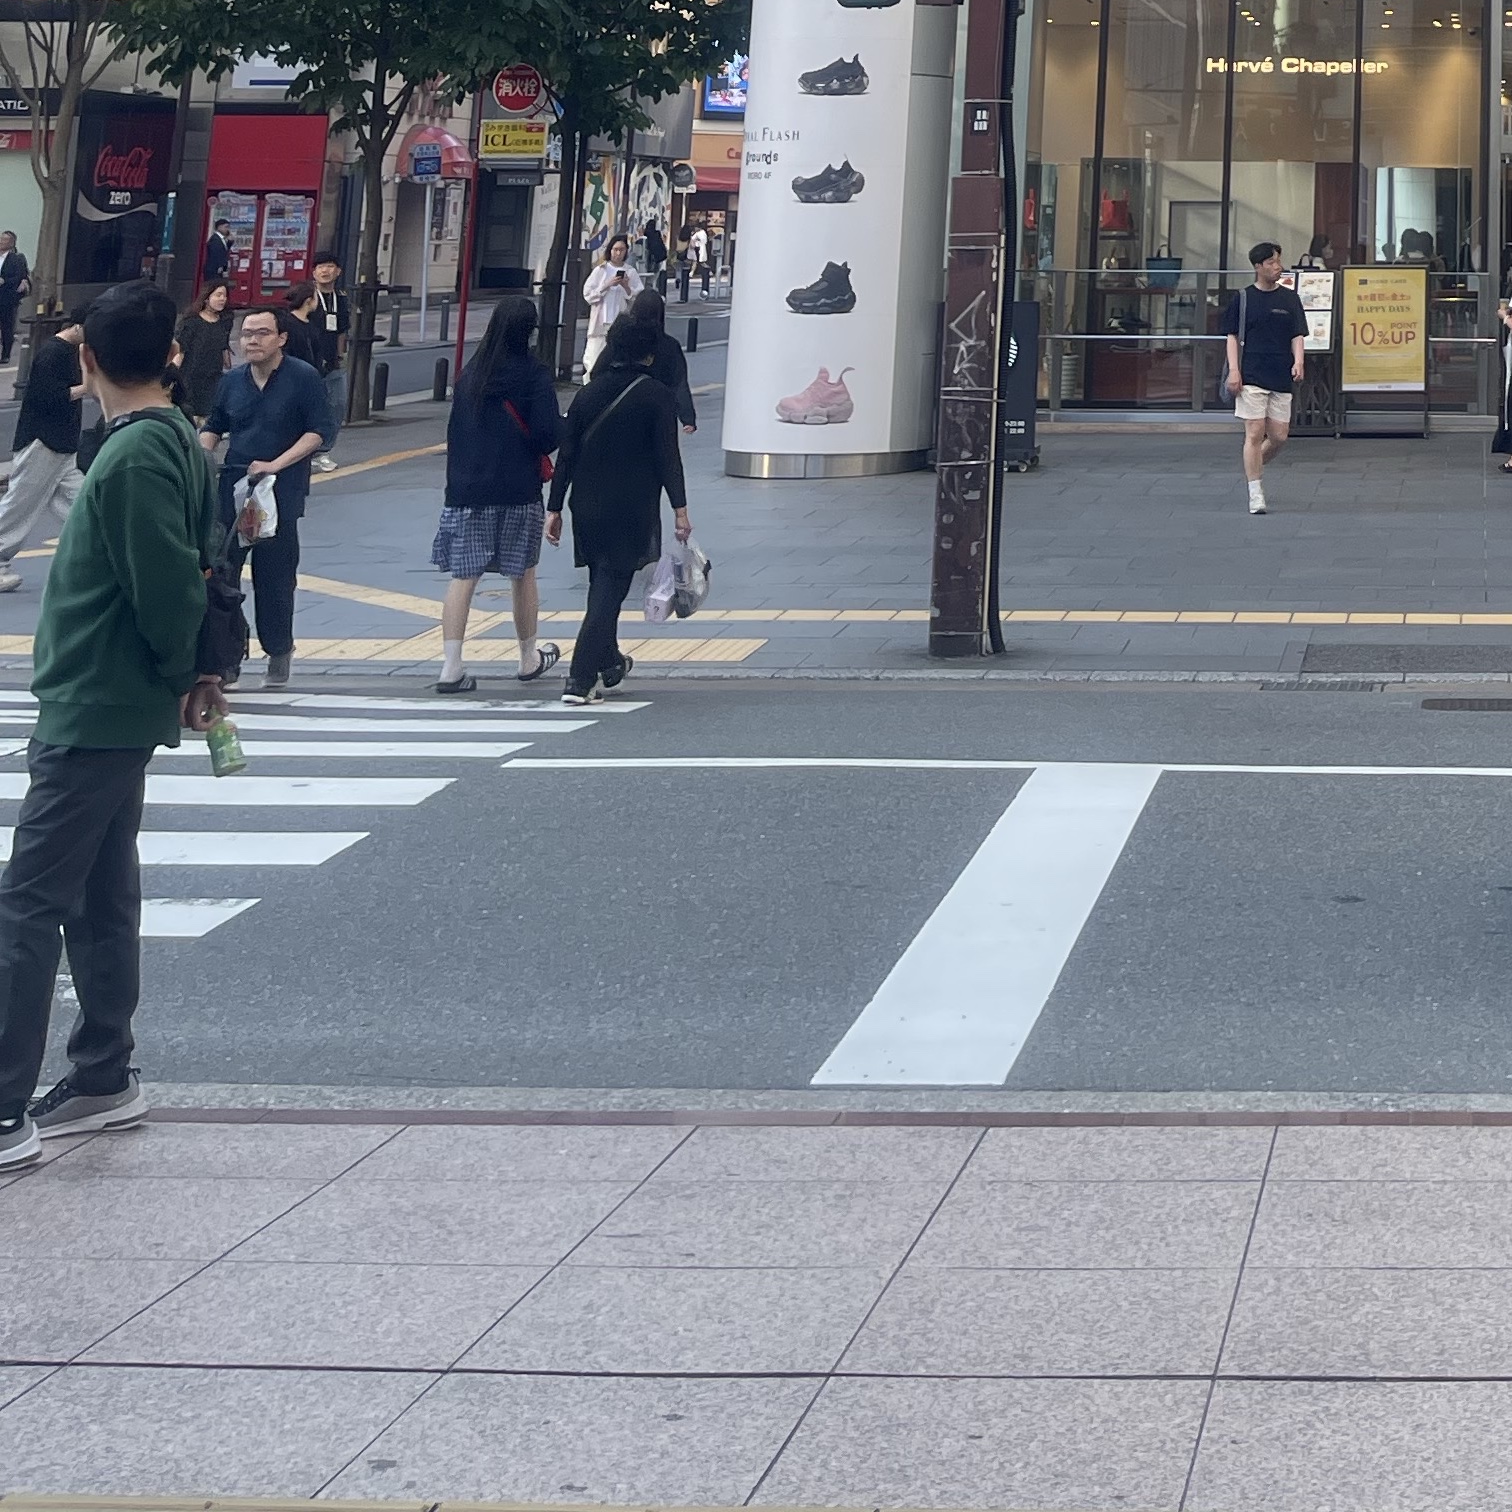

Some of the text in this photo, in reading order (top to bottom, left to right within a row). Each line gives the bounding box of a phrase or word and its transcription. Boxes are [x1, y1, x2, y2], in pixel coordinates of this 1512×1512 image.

[1281, 57, 1389, 76] Chapelier
[497, 78, 538, 97] 消火栓
[484, 134, 512, 147] ICL
[761, 127, 800, 142] FLASH
[108, 191, 132, 205] zero
[1390, 321, 1418, 330] POINT
